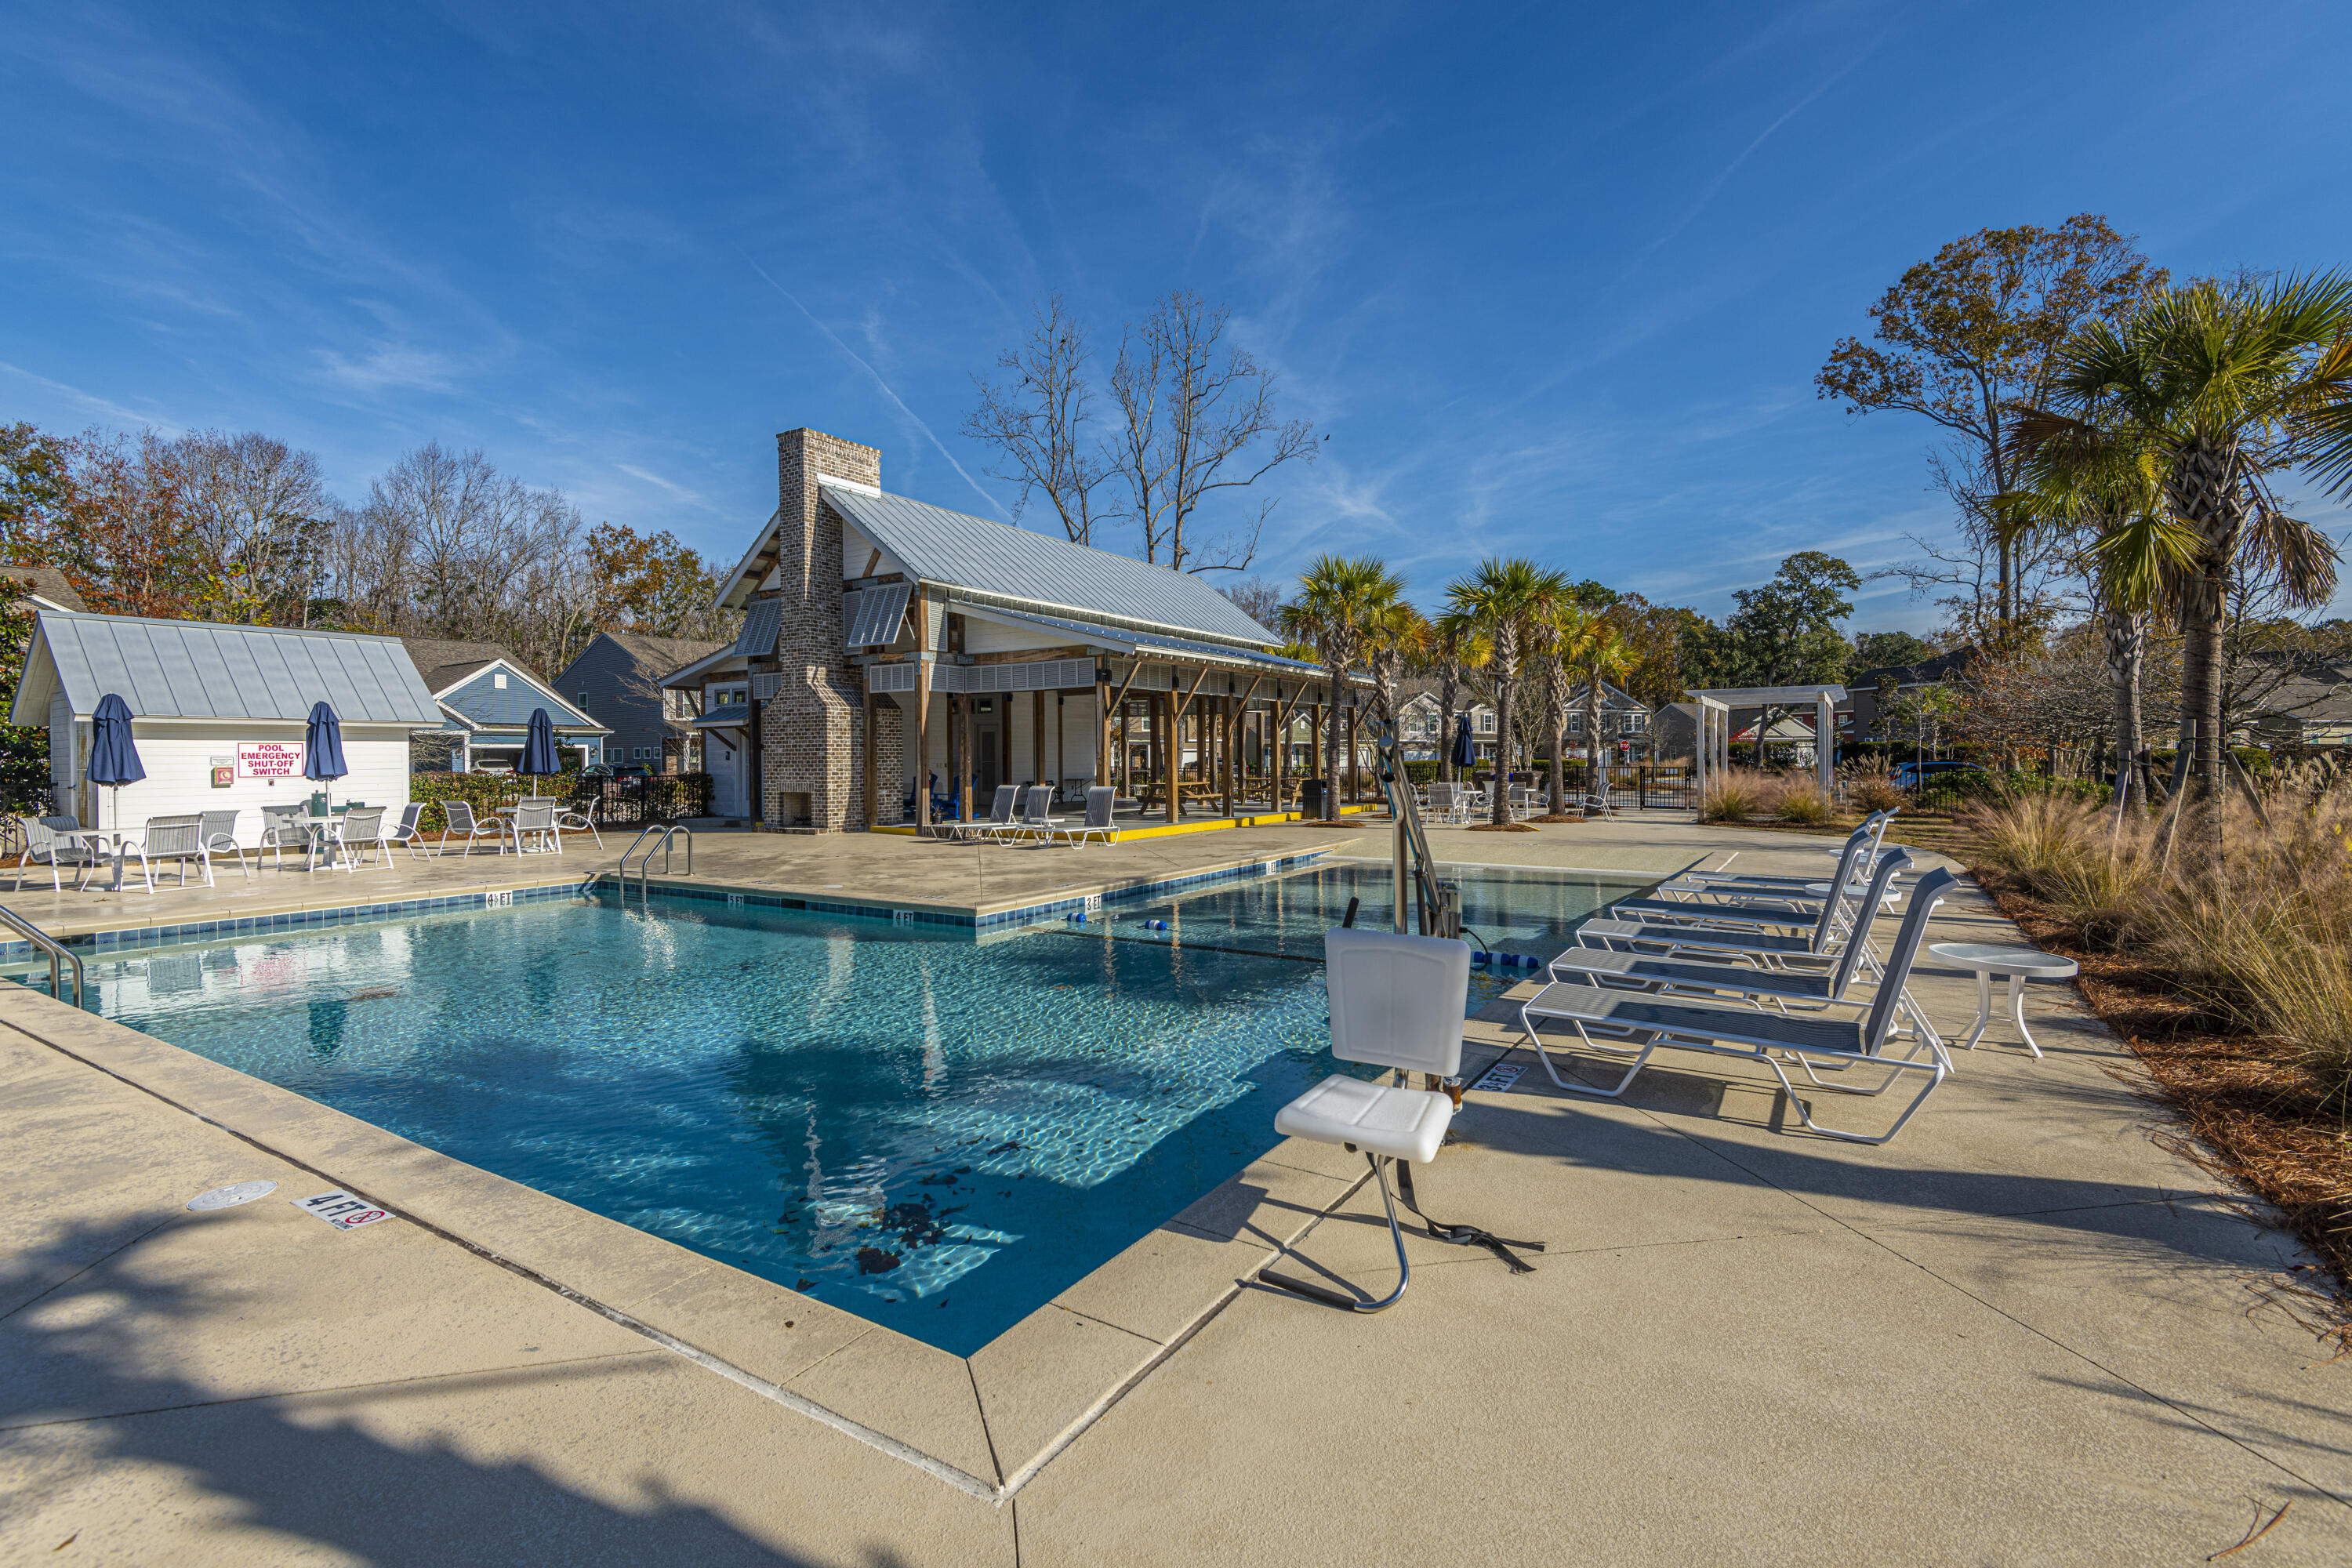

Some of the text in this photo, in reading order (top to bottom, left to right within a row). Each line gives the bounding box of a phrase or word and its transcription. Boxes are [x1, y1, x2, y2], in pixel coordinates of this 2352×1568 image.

[895, 911, 913, 921] 4 FT
[1486, 1073, 1514, 1083] FT
[306, 1194, 368, 1217] 4 FT
